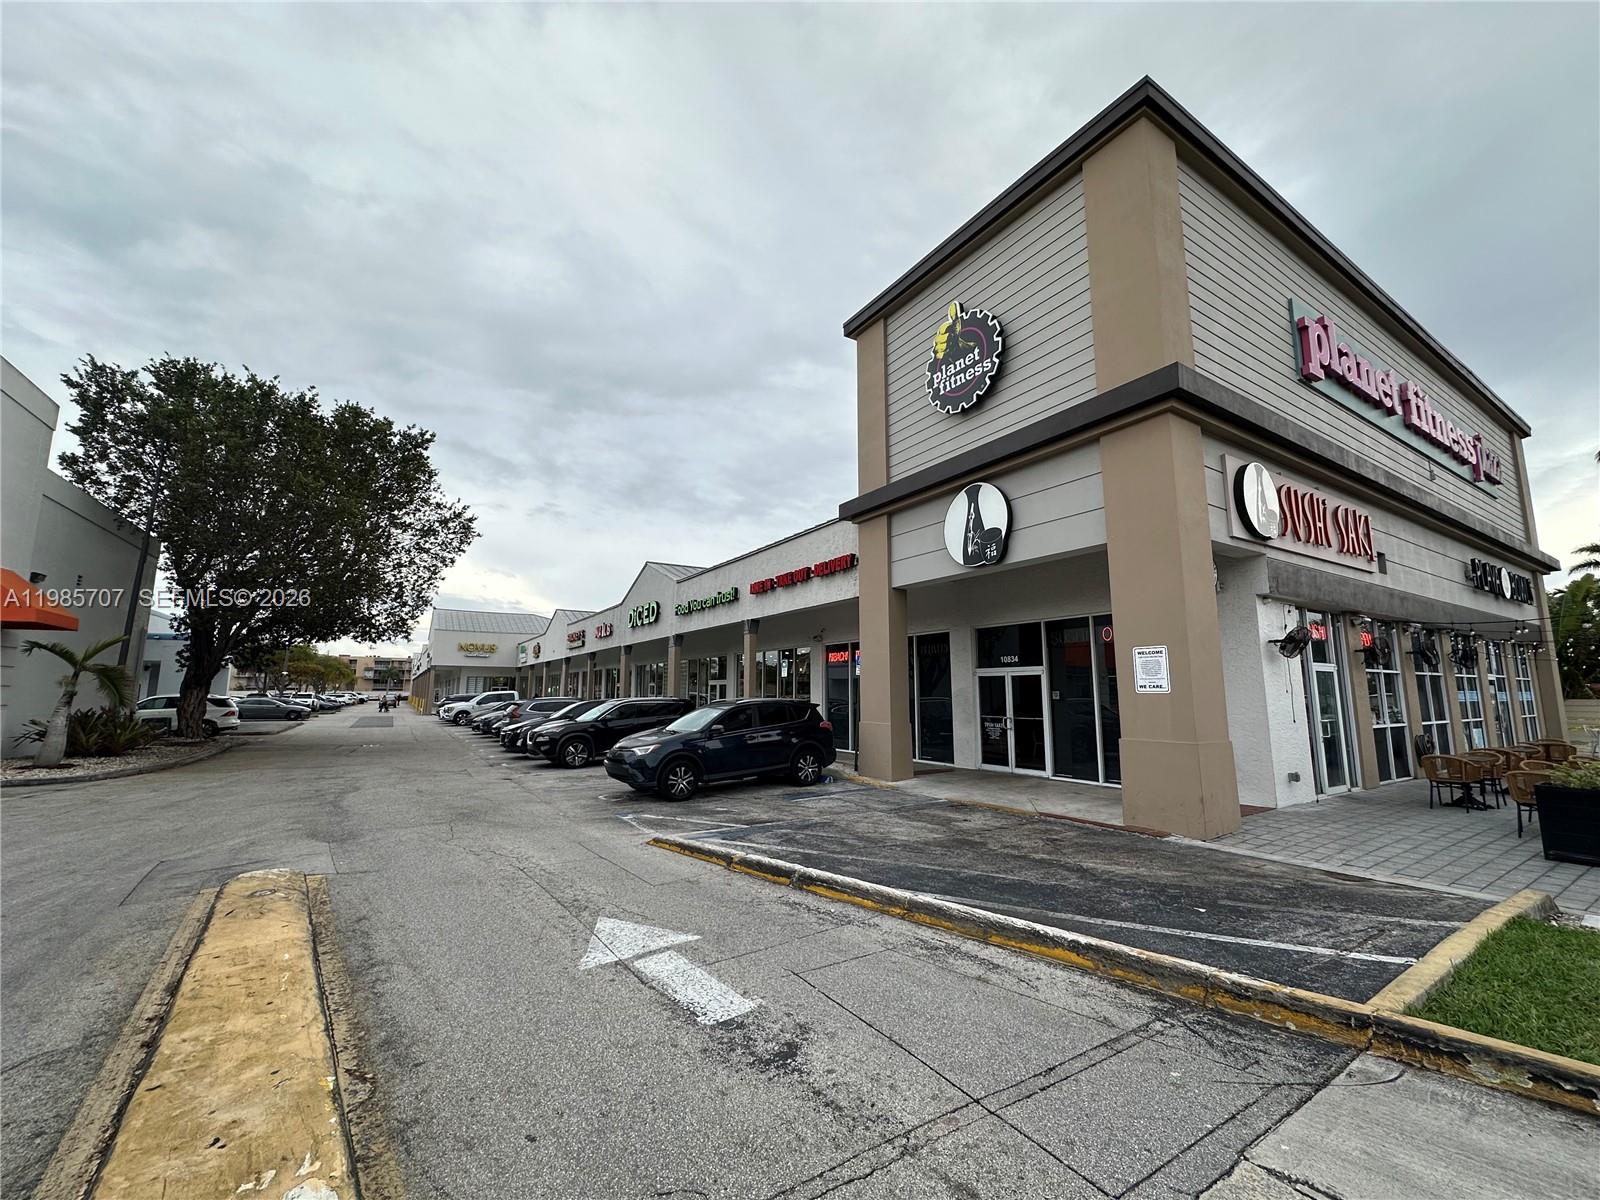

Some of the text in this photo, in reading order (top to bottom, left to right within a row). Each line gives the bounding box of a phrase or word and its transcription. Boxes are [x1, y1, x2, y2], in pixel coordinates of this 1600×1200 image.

[933, 345, 980, 389] planet
[938, 357, 992, 395] fitness
[1297, 315, 1402, 416] planet
[1400, 380, 1477, 466] fitness
[813, 553, 856, 577] DELIVERY
[1000, 655, 1019, 663] 10834
